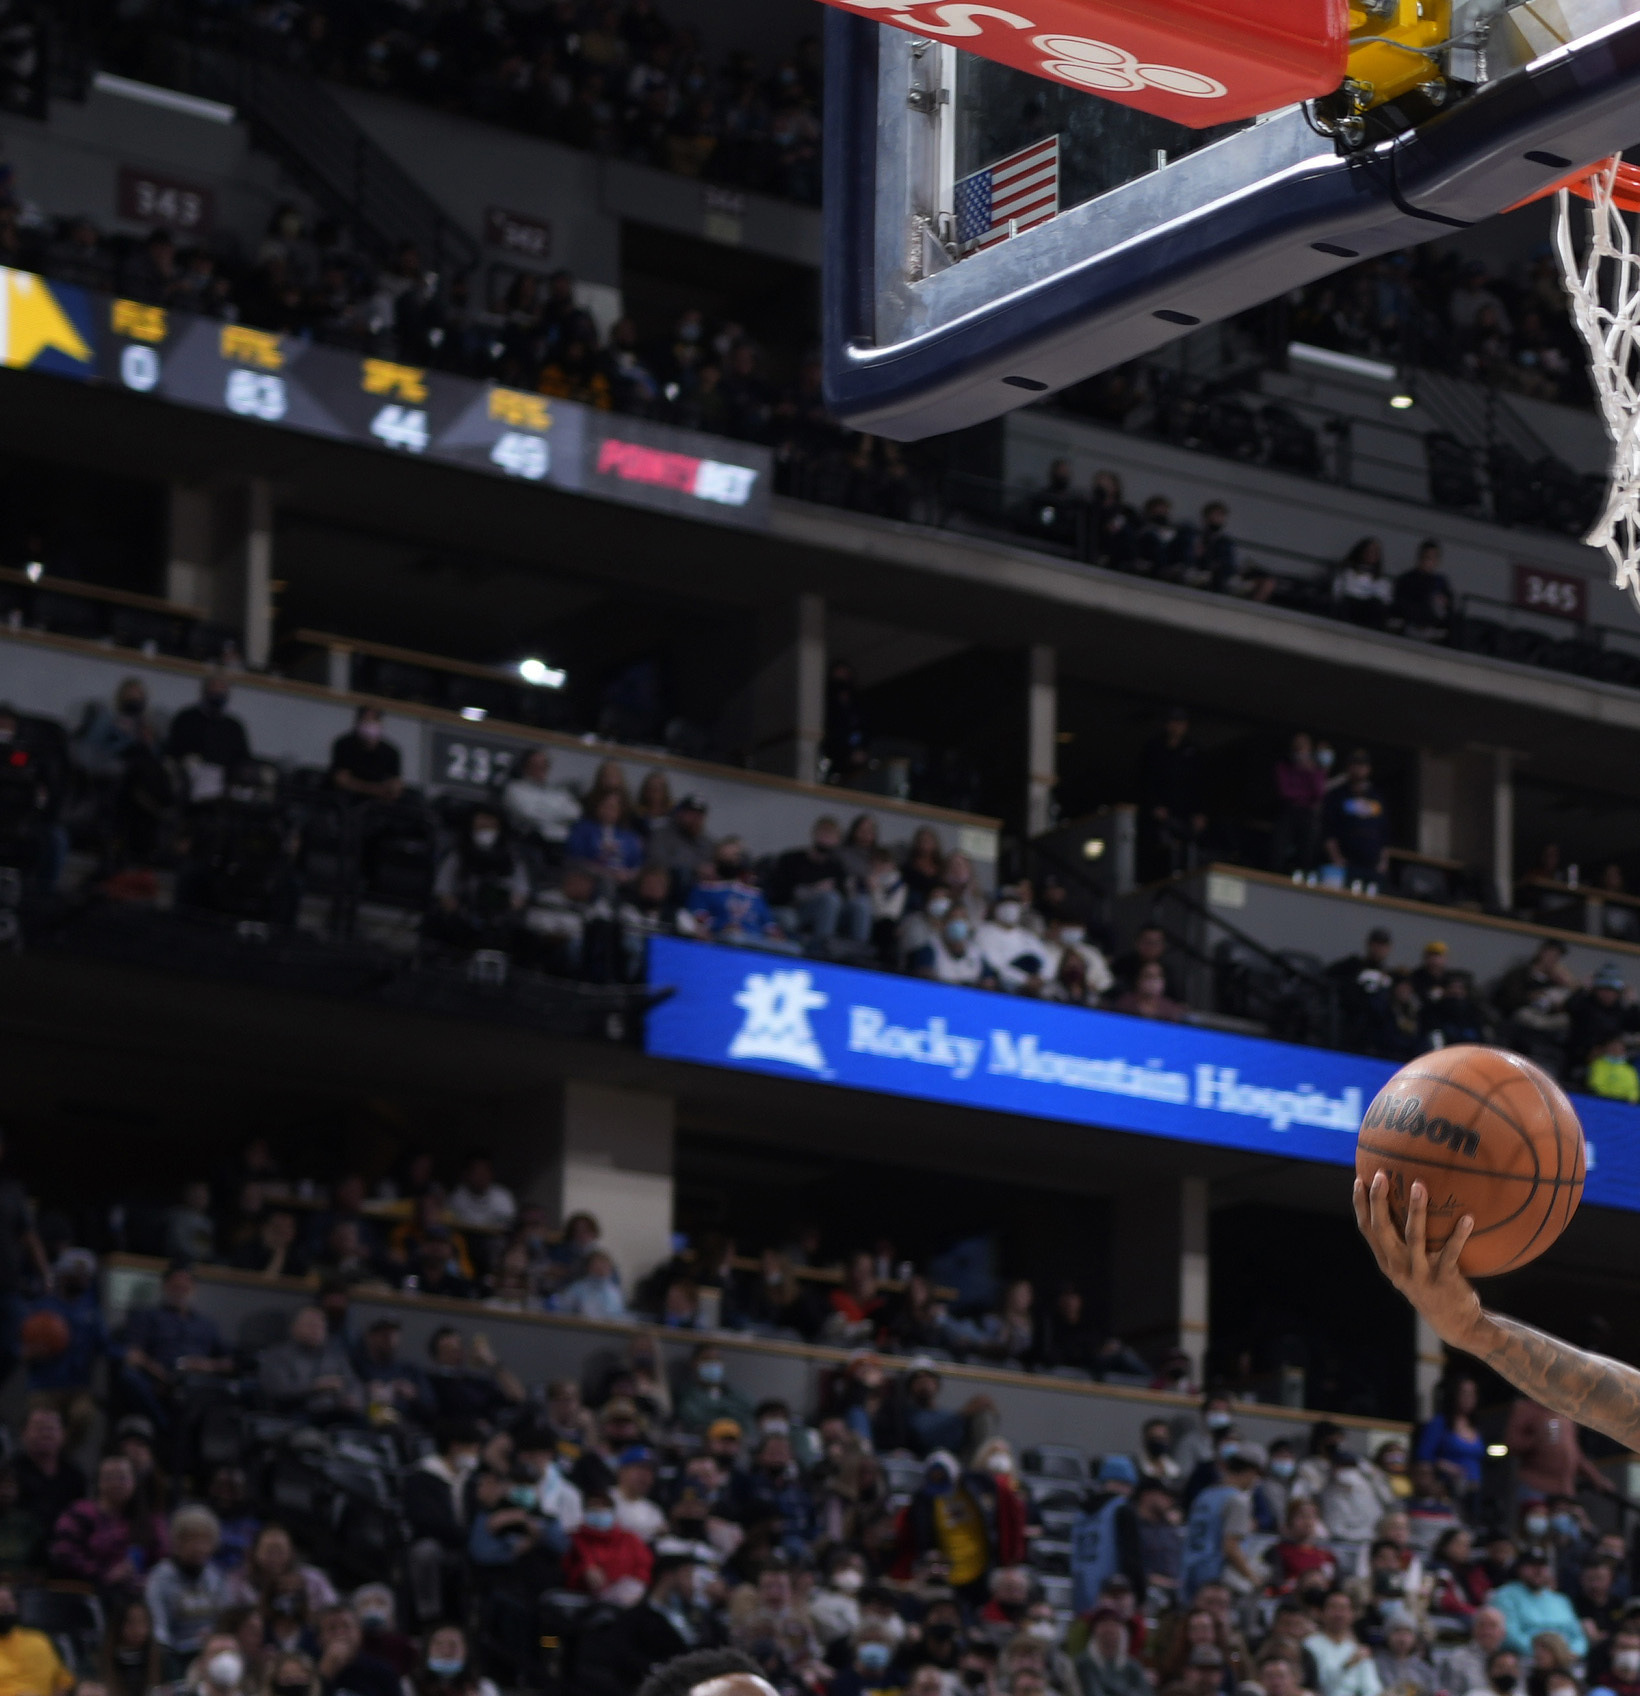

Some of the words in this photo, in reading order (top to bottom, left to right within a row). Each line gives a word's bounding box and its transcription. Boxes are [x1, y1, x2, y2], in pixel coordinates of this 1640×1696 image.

[370, 404, 430, 453] 44
[847, 1004, 983, 1079] Rocky
[988, 1028, 1189, 1106] Mountain
[1195, 1062, 1362, 1132] Hospital
[1364, 1093, 1480, 1160] Wilson
